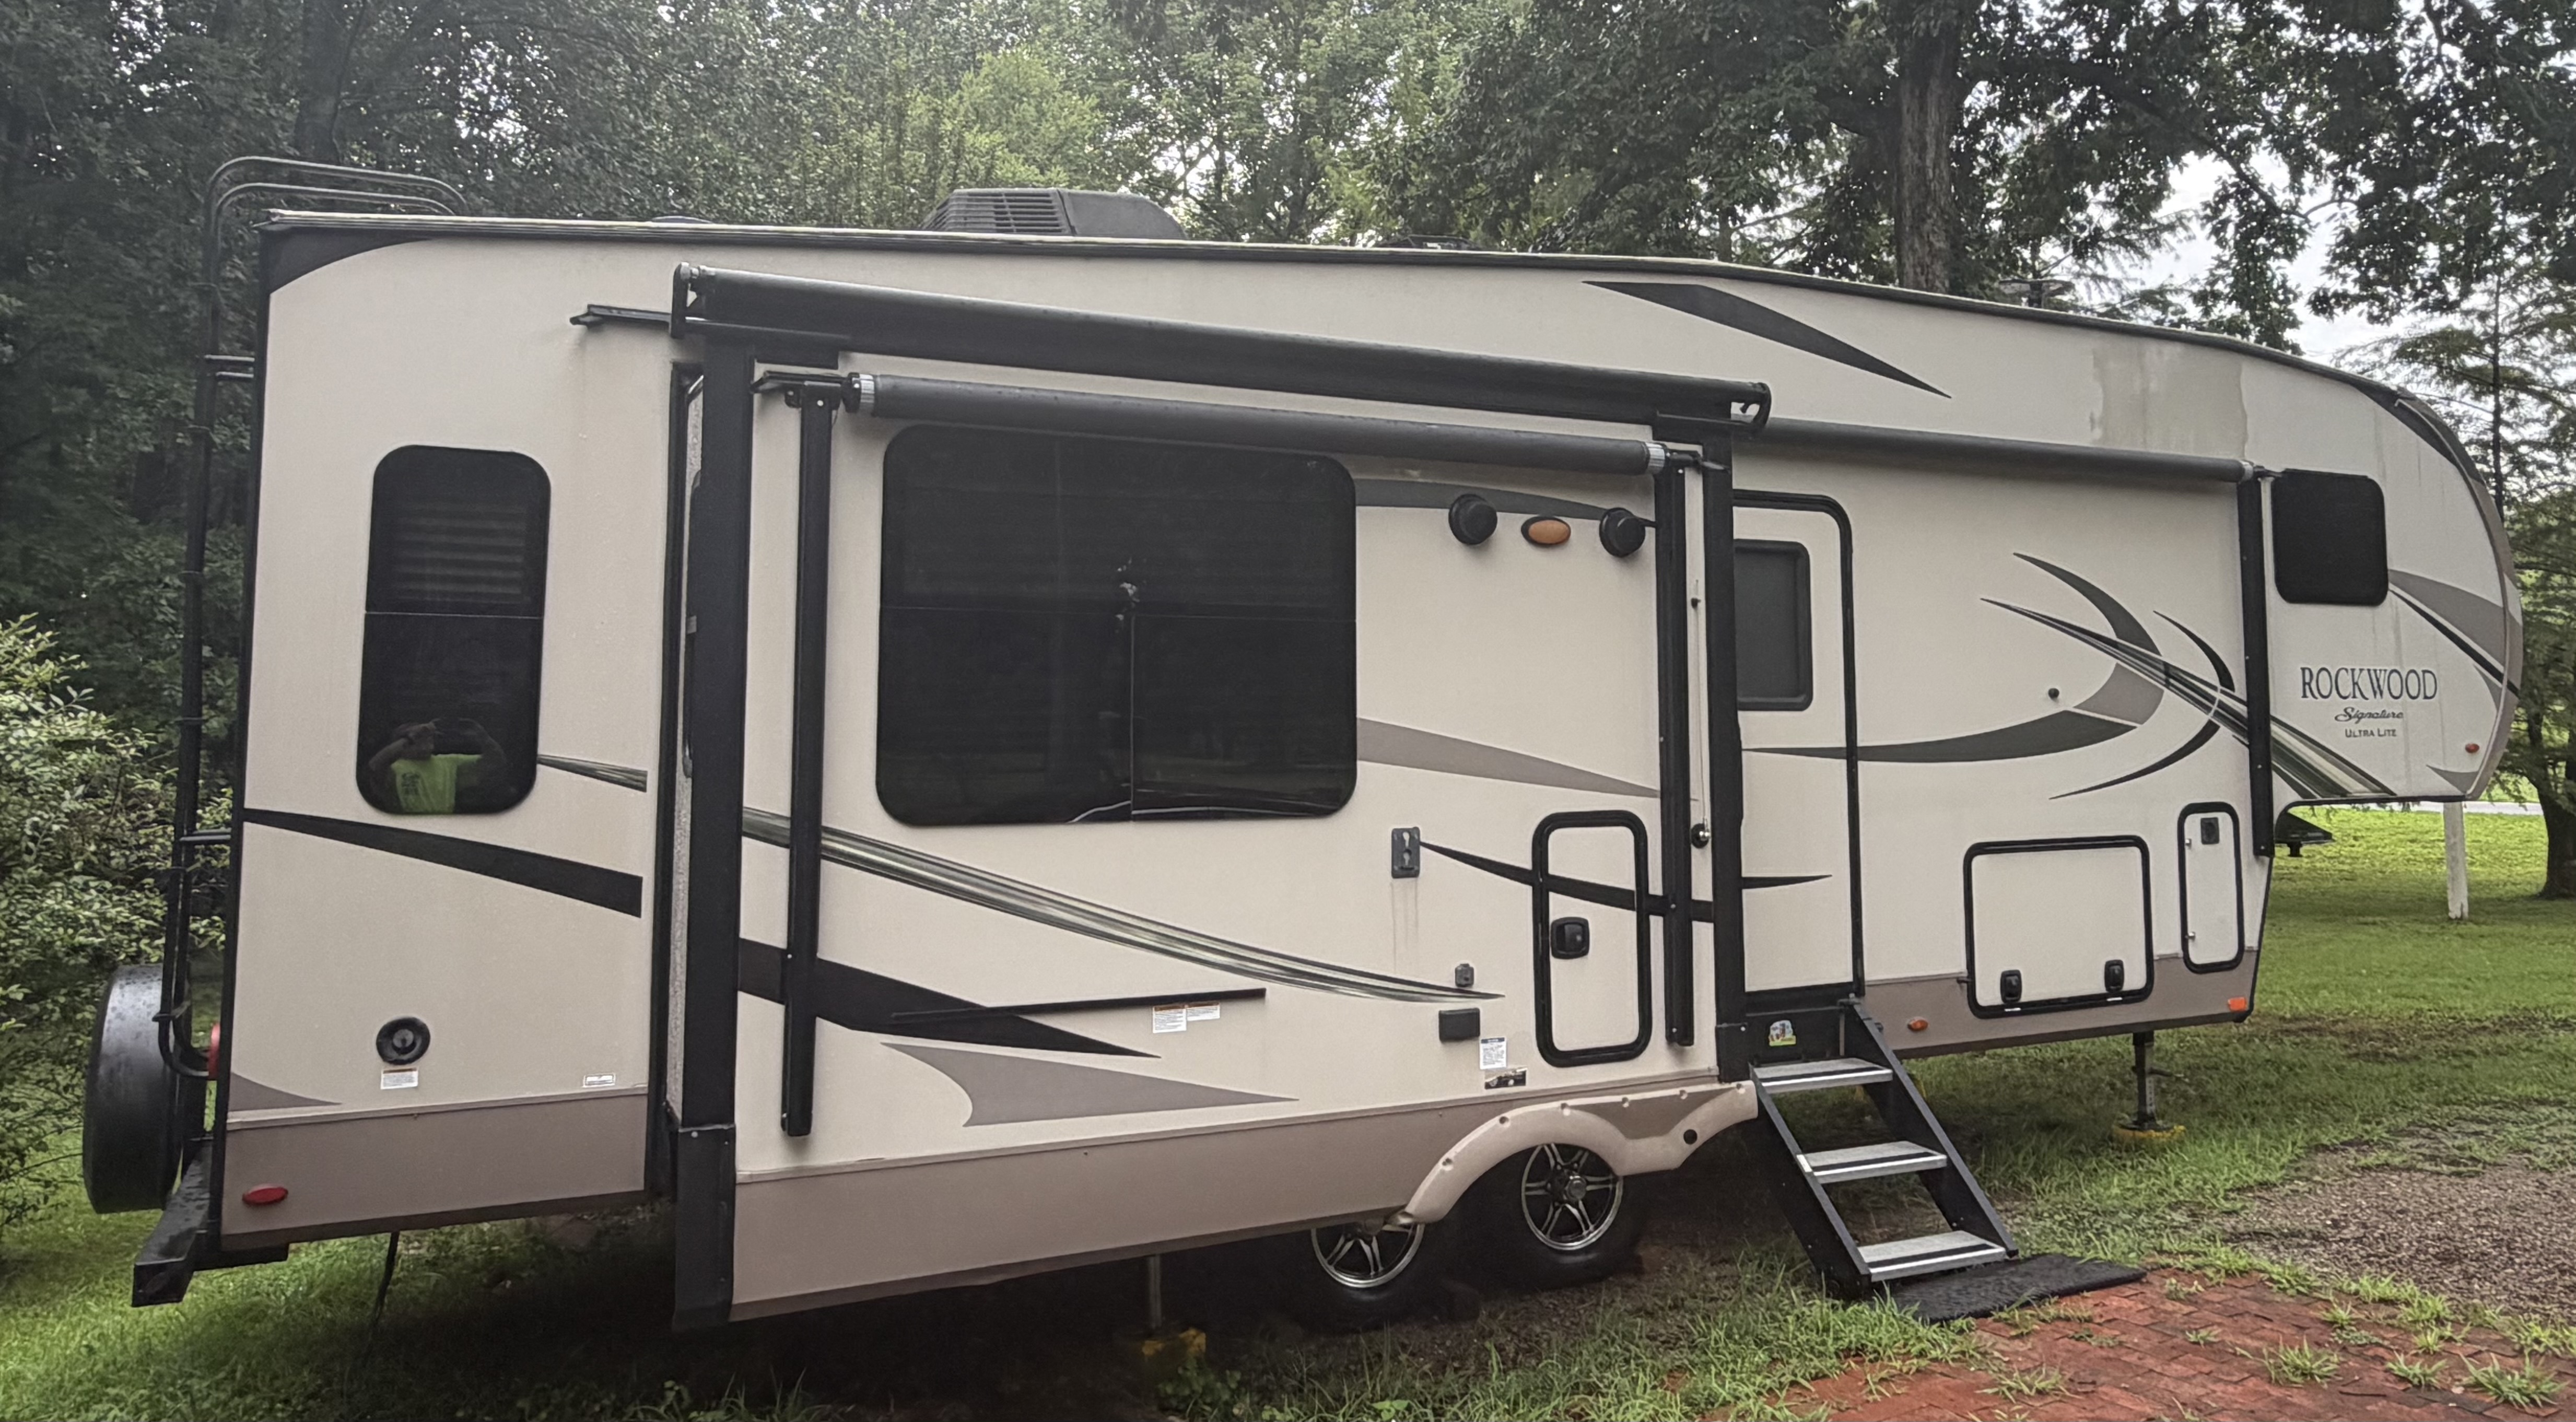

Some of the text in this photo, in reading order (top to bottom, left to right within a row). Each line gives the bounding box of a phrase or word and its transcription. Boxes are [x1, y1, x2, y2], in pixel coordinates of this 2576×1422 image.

[2300, 667, 2438, 700] ROCKWOOD
[2334, 707, 2404, 724] Signature
[2345, 729, 2375, 737] ULTRA
